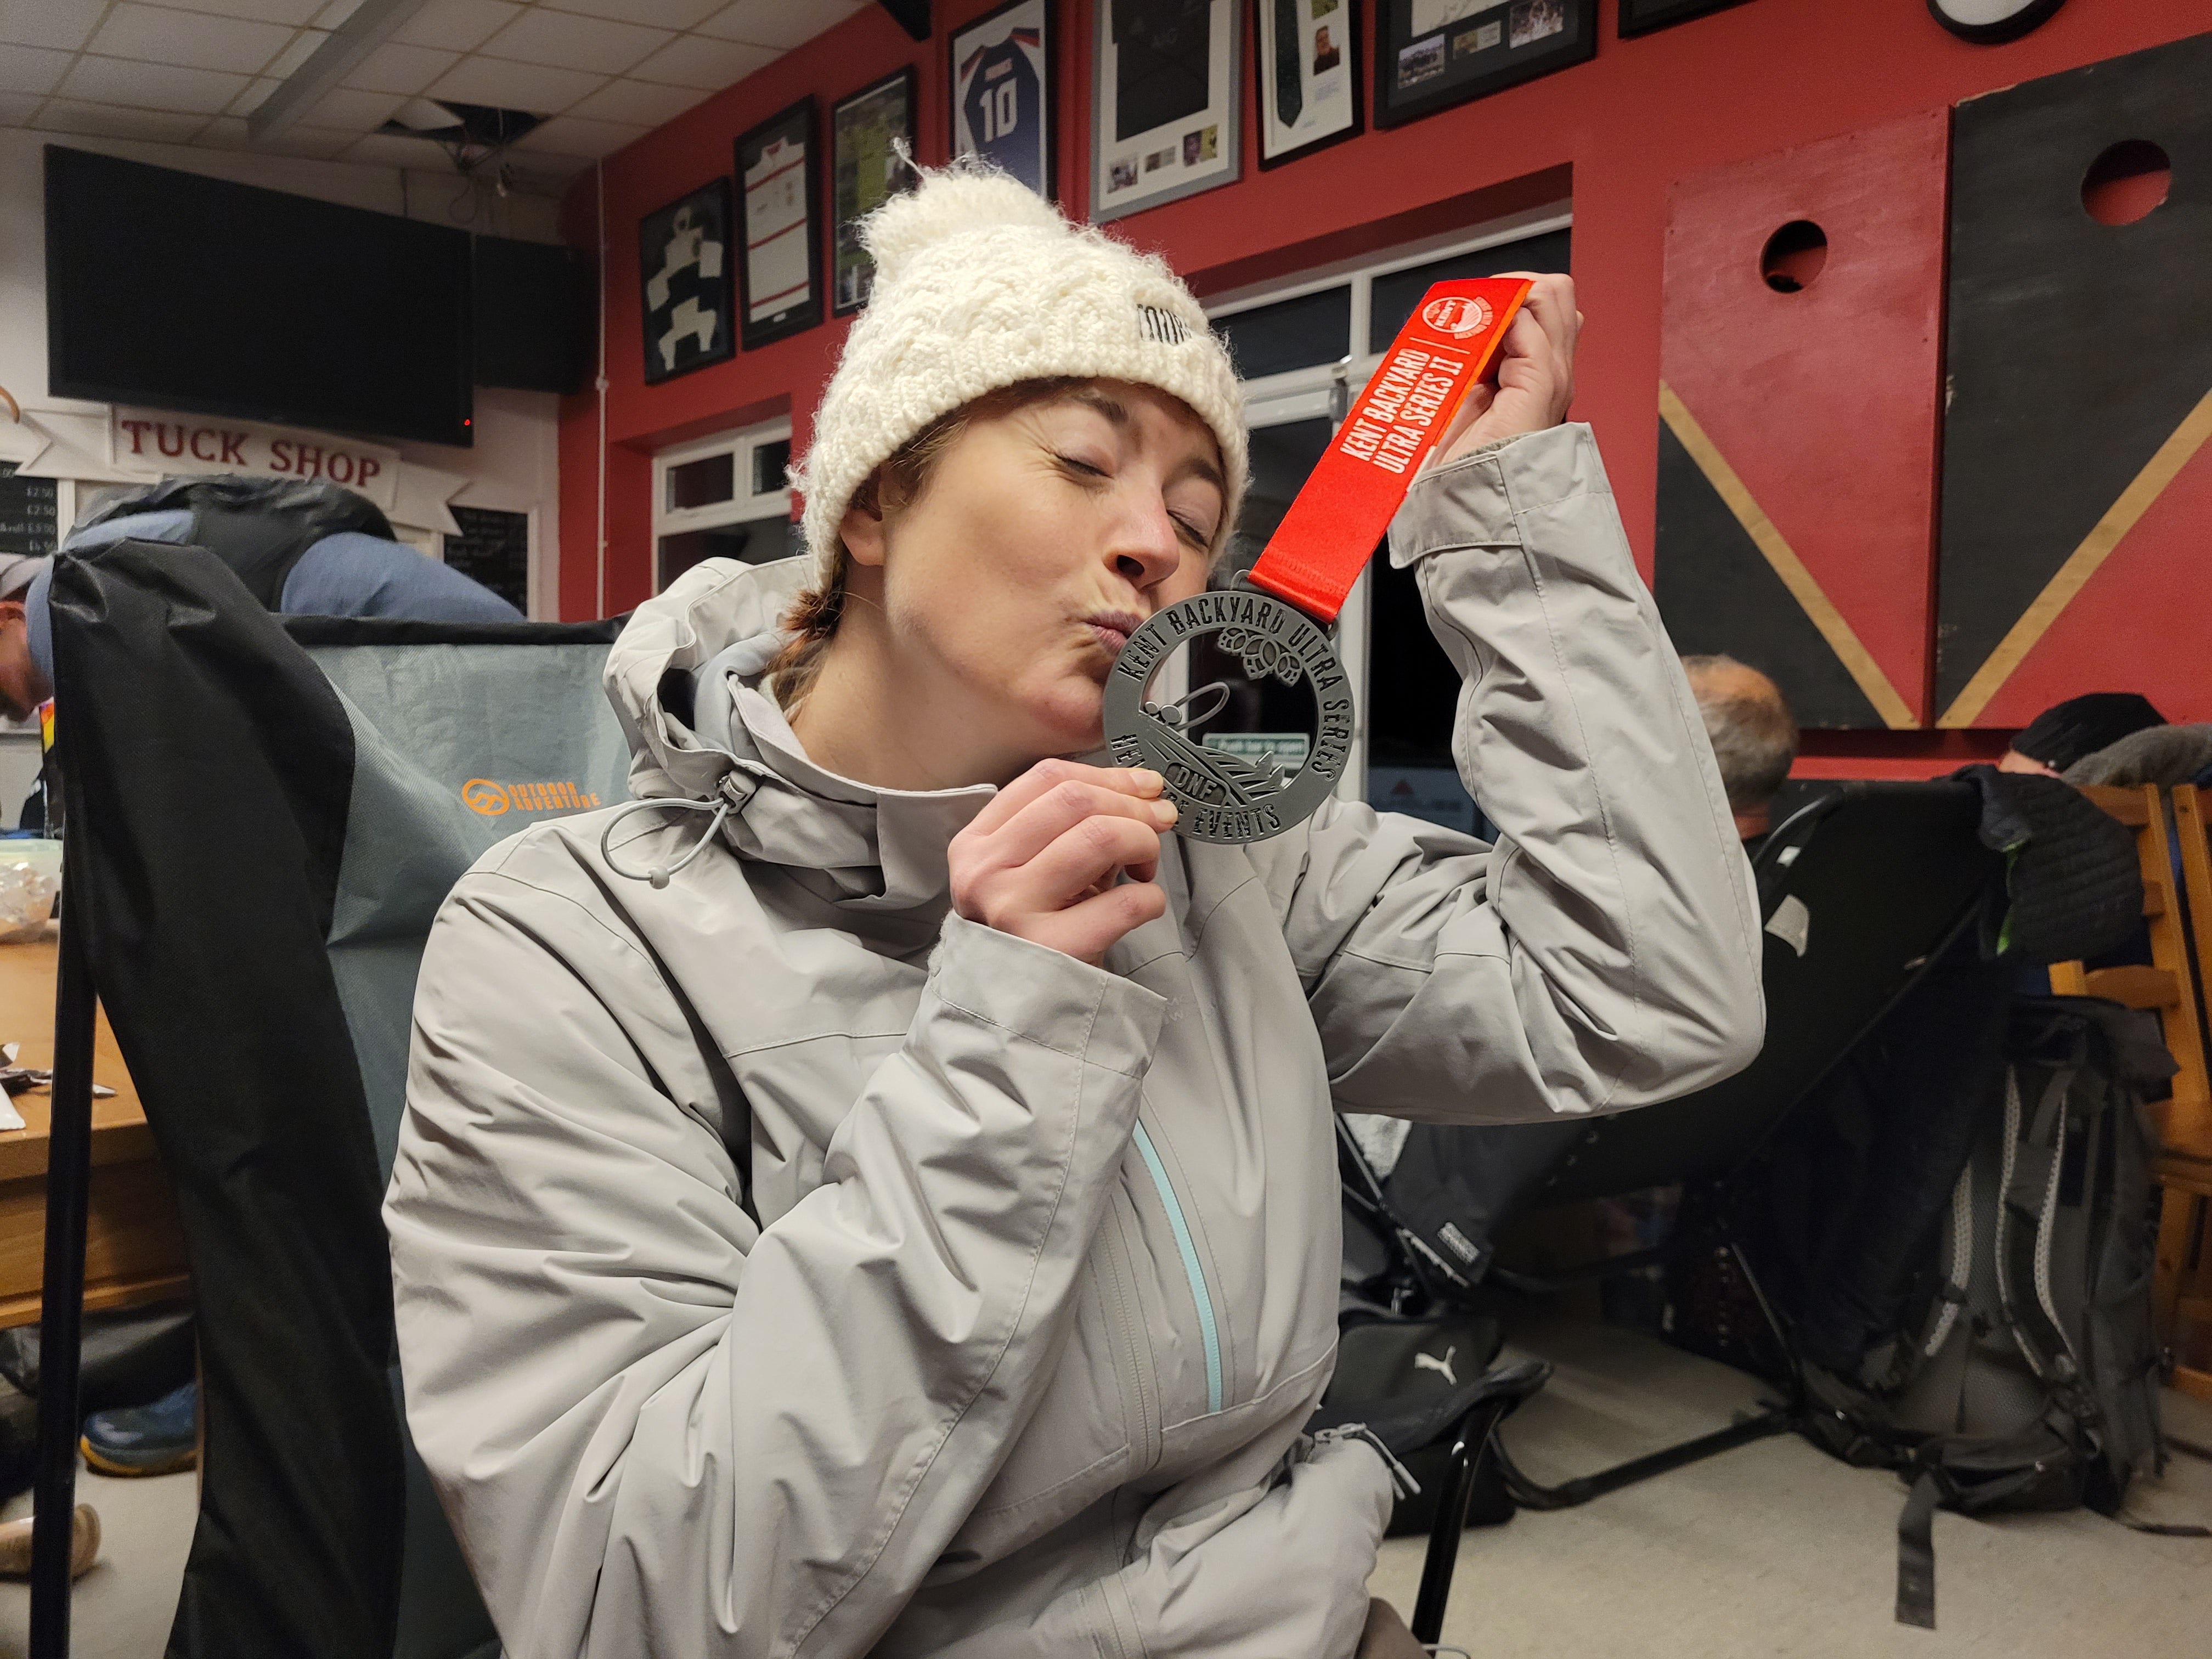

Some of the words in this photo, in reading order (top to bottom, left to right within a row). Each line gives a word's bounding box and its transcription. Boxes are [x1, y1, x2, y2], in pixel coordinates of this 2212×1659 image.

[979, 77, 1018, 143] 10
[1362, 348, 1431, 424] BACKYARD
[121, 420, 250, 466] TUCK
[270, 440, 381, 487] SHOP
[1340, 417, 1387, 462] KENT
[1372, 425, 1425, 474] ULTRA
[1400, 373, 1454, 427] SERIES
[1166, 596, 1286, 635] BACKYARD
[1117, 624, 1167, 682] KENT
[1288, 623, 1343, 692] ULTRA
[1310, 699, 1351, 782] SERIES
[1173, 766, 1217, 799] DNF
[1192, 804, 1280, 839] EVENTS
